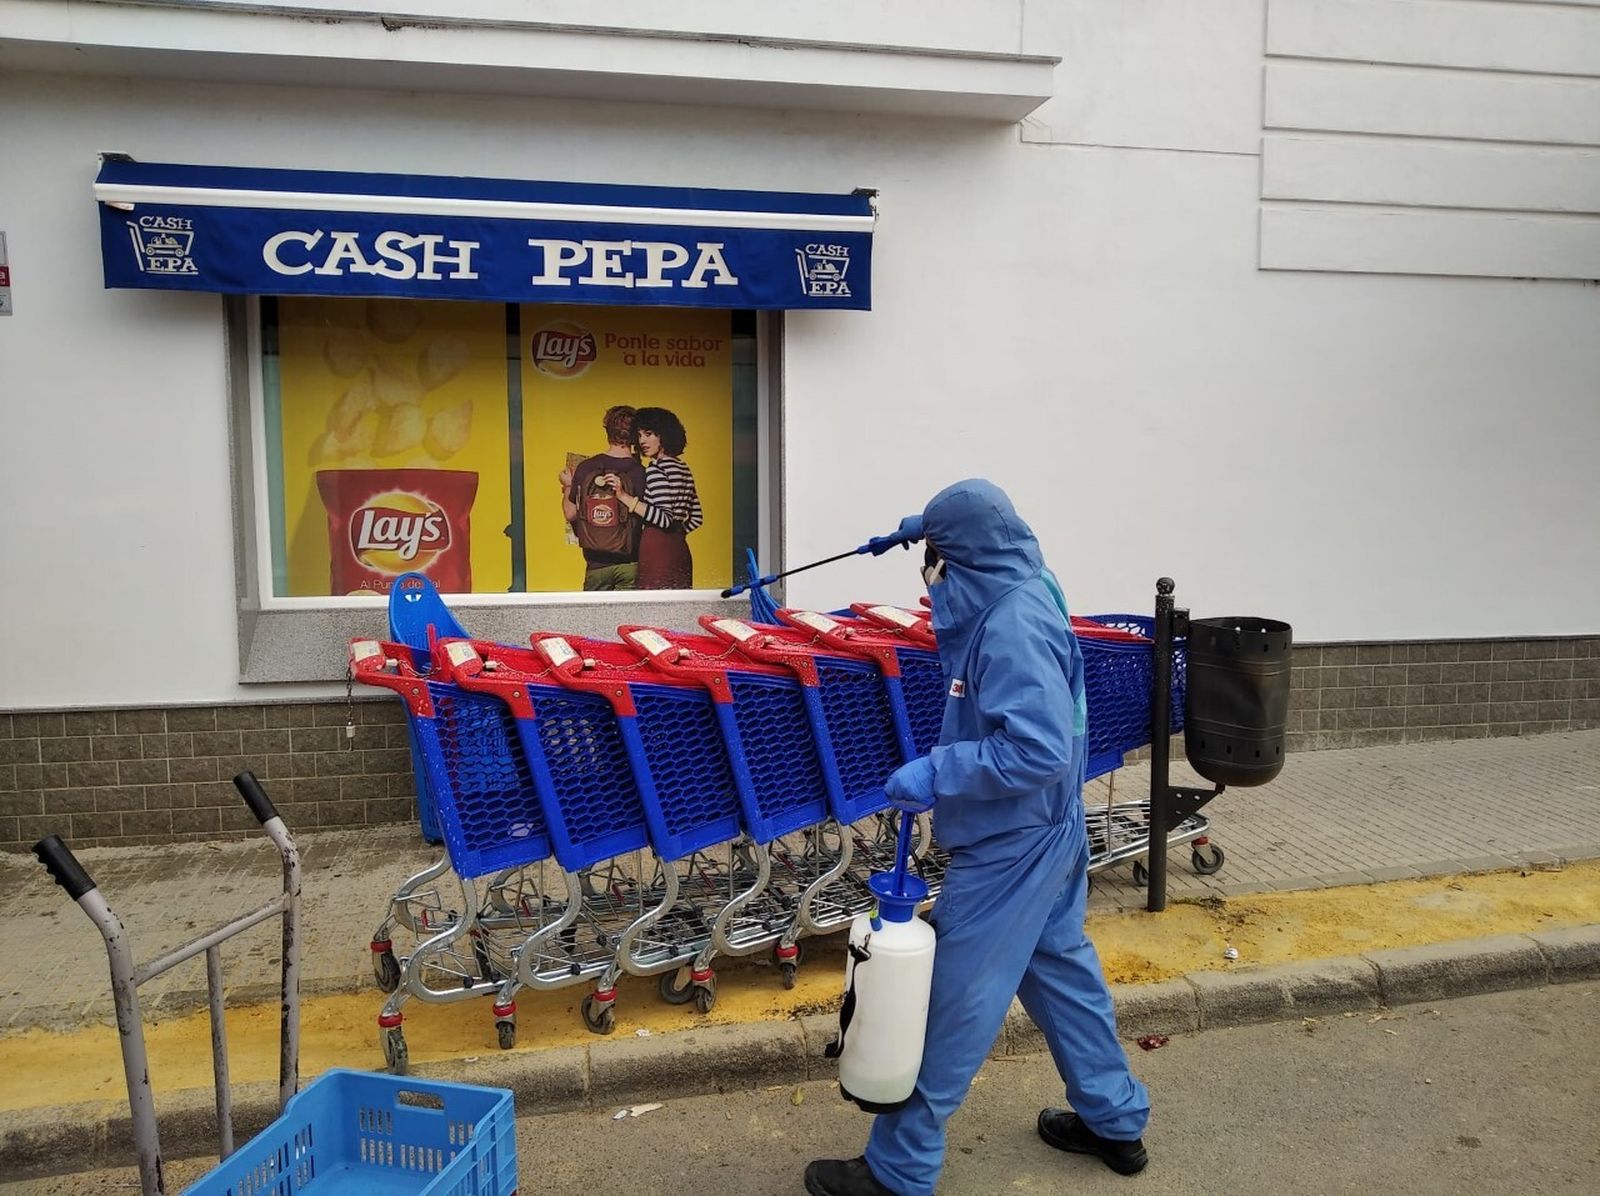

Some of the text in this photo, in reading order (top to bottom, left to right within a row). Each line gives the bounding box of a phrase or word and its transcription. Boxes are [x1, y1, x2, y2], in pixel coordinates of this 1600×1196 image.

[139, 215, 193, 230] CASH
[262, 229, 738, 288] CASH PEPA
[805, 243, 849, 257] CASH
[146, 257, 198, 272] EPA
[809, 281, 851, 295] EPA
[536, 332, 592, 368] Lay's
[604, 333, 723, 352] Ponle sabor
[624, 351, 706, 368] a la vida
[358, 510, 443, 560] Lay's
